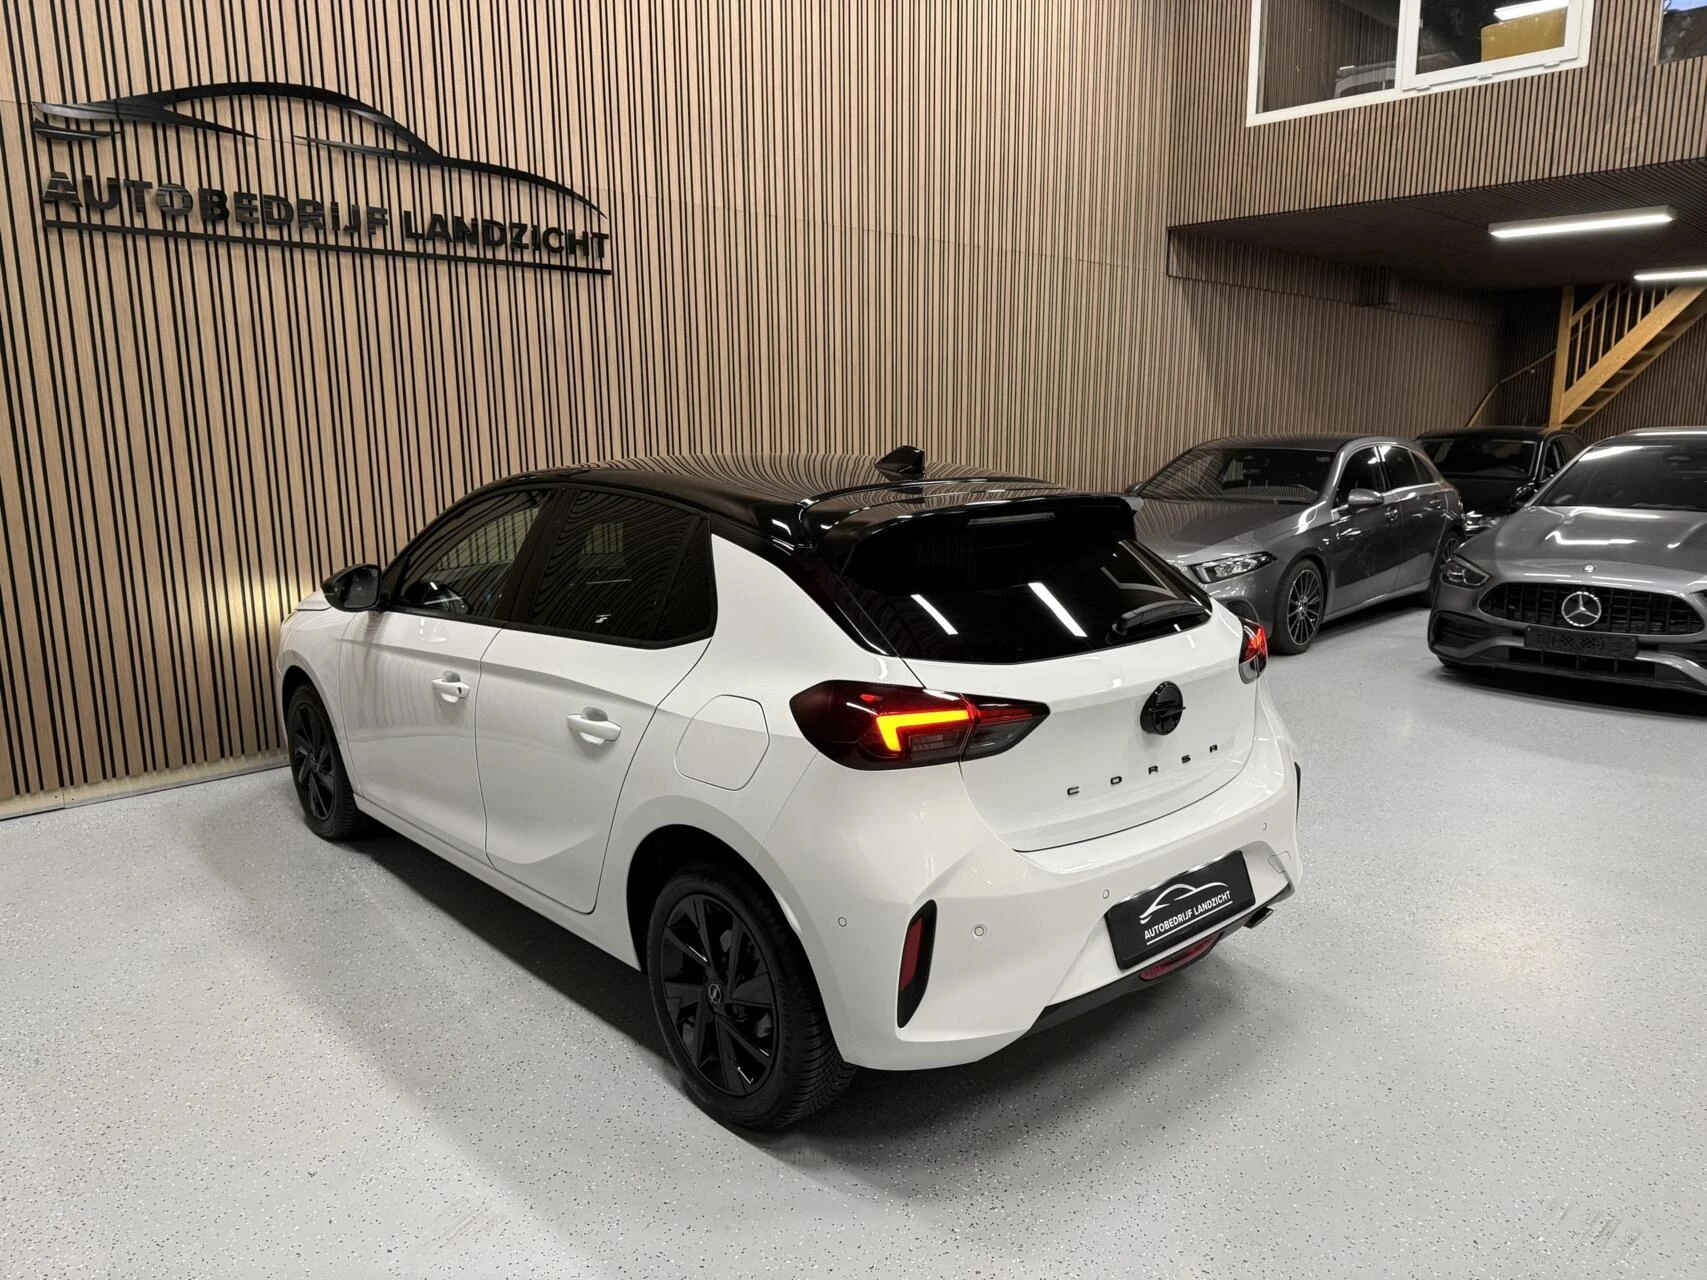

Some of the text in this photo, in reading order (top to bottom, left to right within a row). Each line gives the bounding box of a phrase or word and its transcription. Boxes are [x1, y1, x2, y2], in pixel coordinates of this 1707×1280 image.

[42, 170, 610, 258] AUTOBEDRIJF LANDZICHT
[1067, 744, 1218, 796] CORSA
[1144, 890, 1232, 940] AUTOBEDRIJF LANDZICHT
